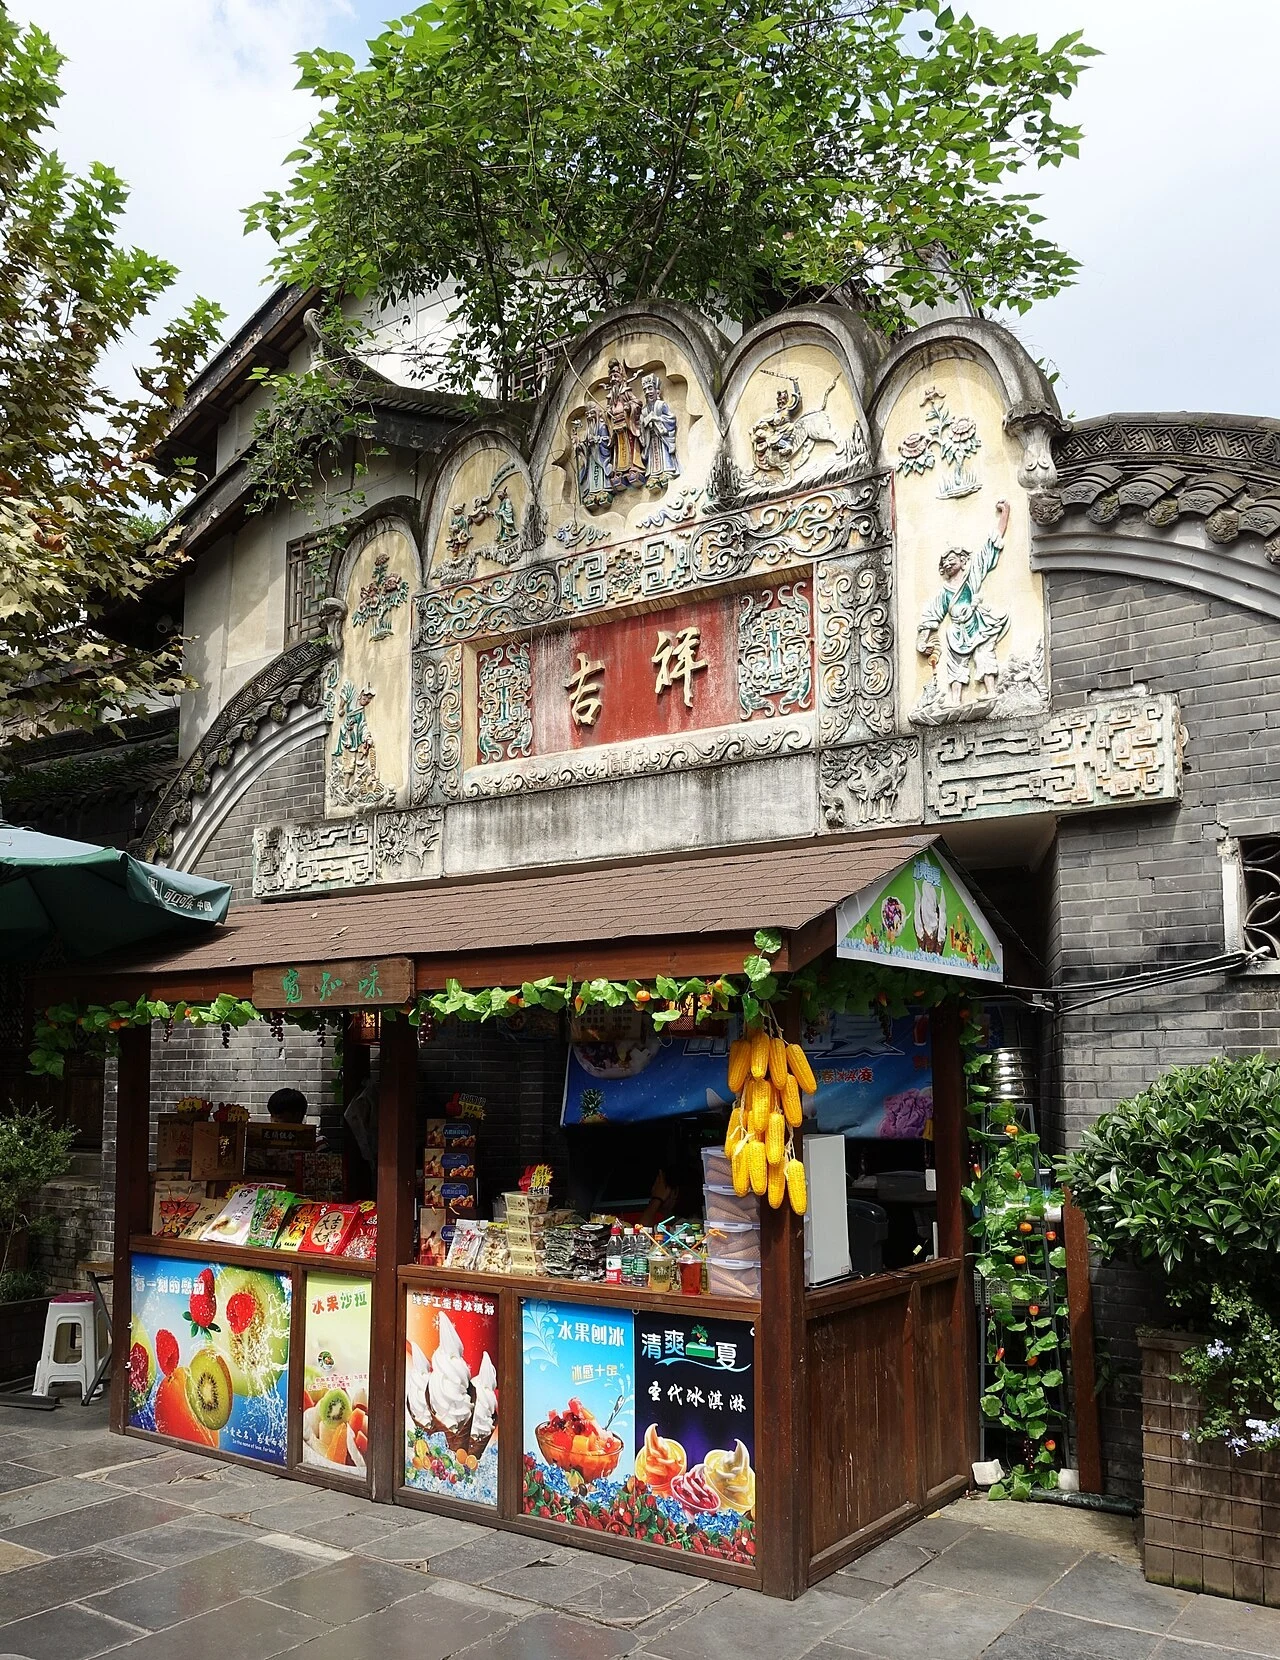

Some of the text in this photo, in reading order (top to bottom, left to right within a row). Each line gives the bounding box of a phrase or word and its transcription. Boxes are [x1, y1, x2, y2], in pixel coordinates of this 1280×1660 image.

[564, 626, 709, 726] 吉祥
[164, 888, 196, 910] 可口可乐
[312, 1291, 368, 1315] 水果沙拉
[557, 1320, 625, 1347] 水果刨冰
[648, 1381, 748, 1413] 圣代冰淇淋
